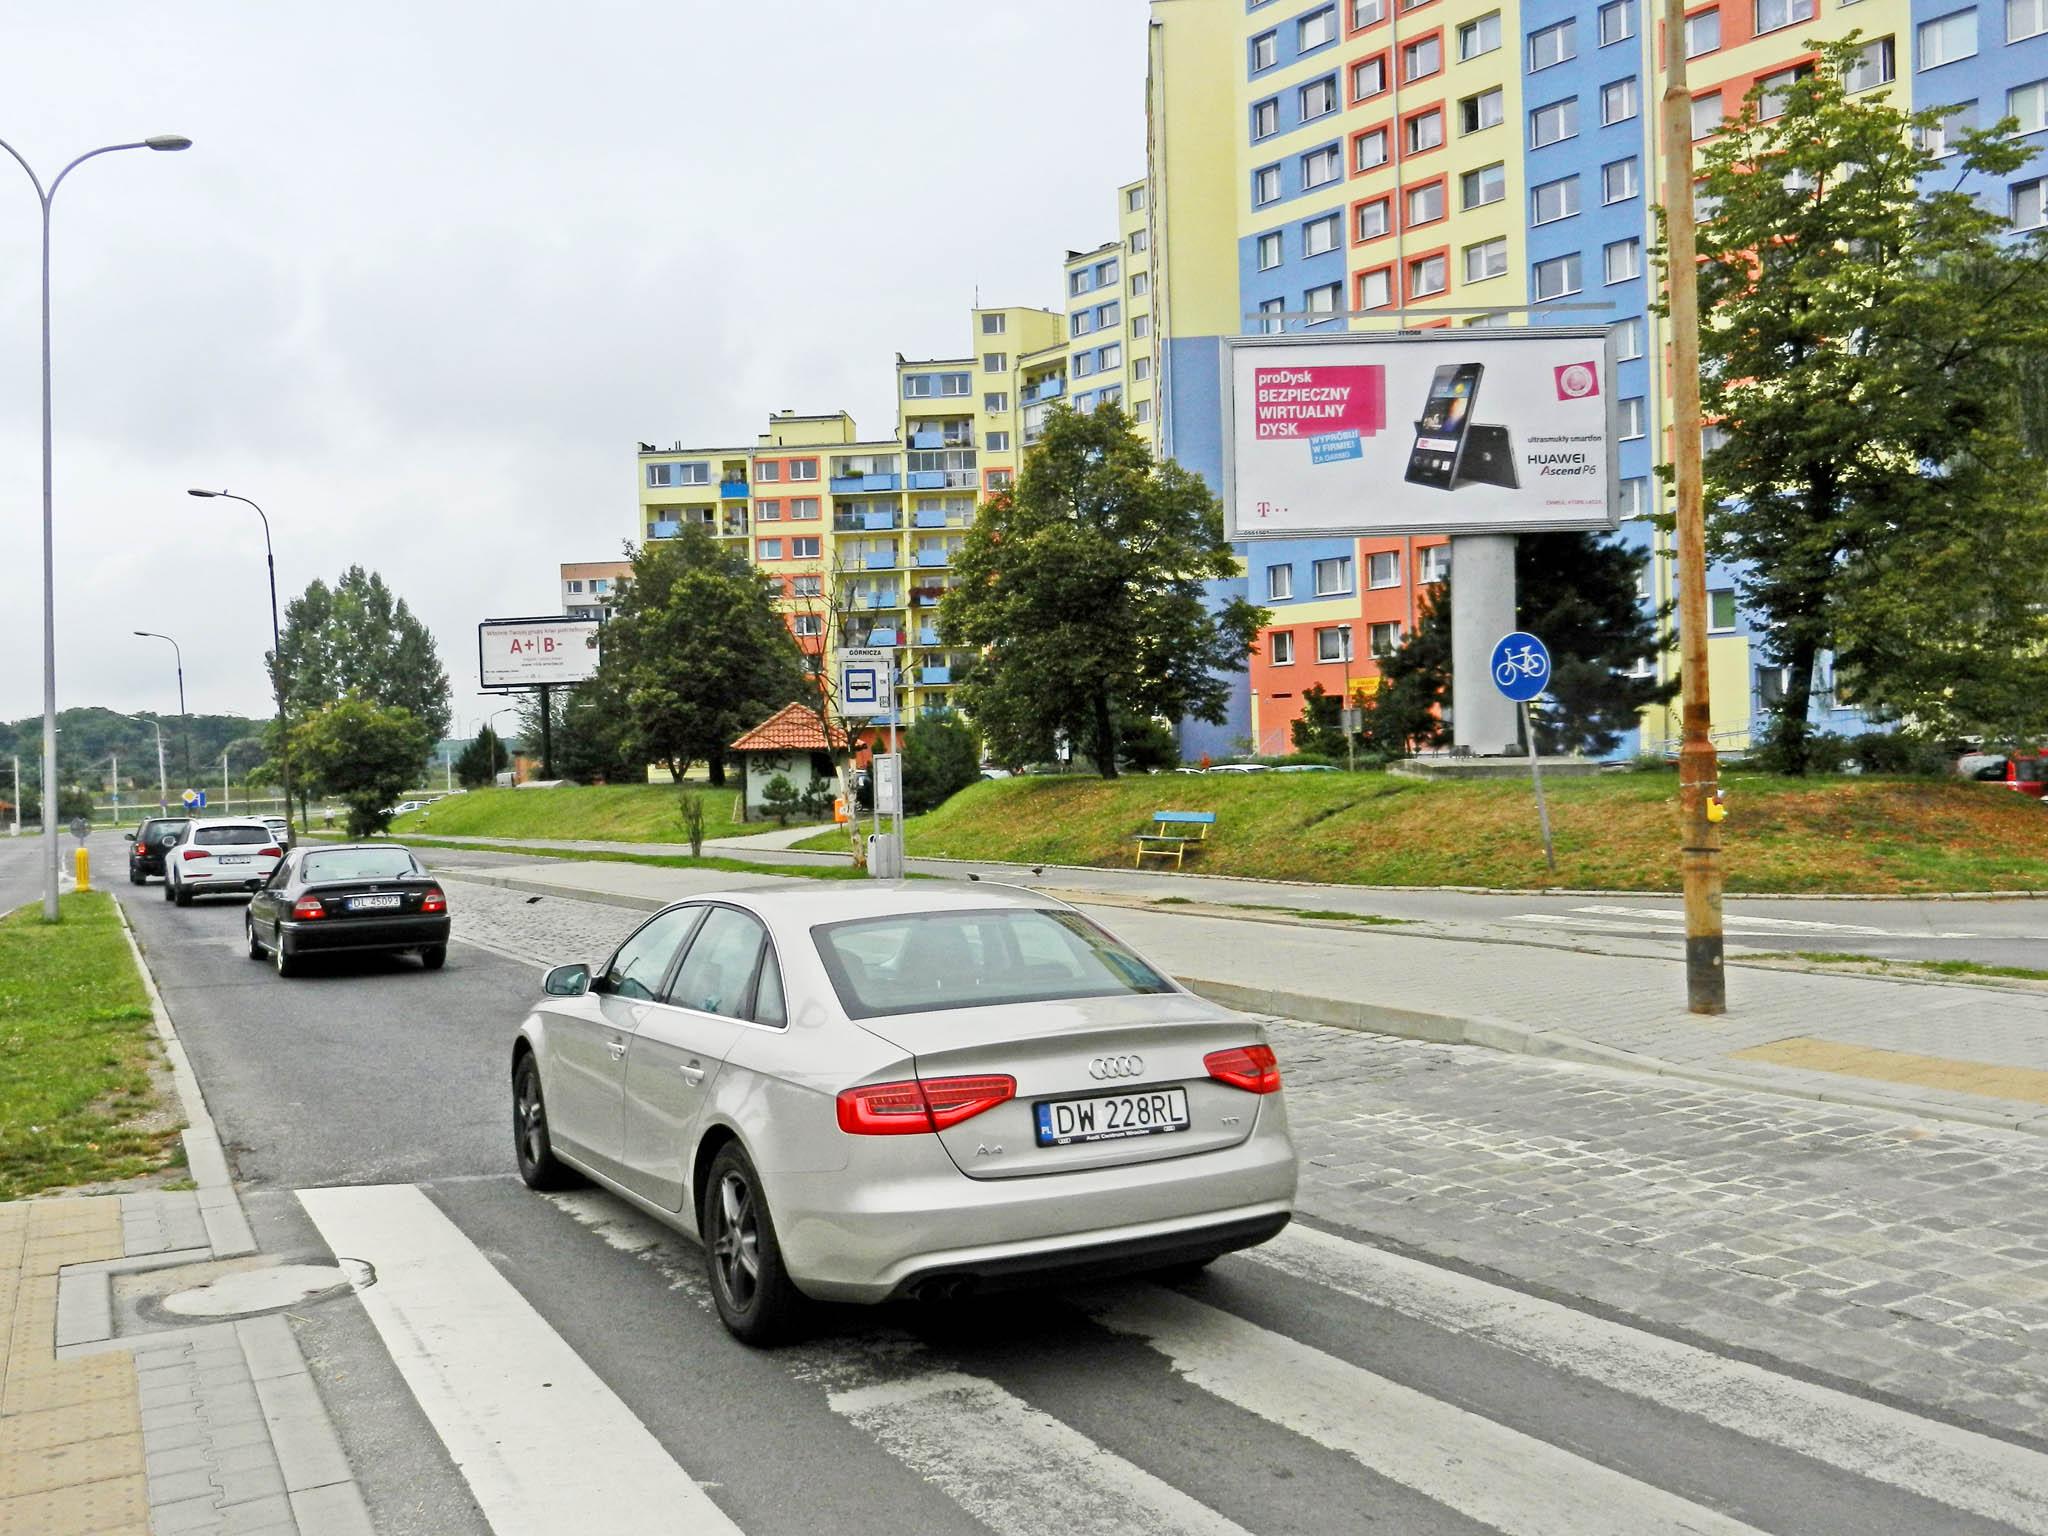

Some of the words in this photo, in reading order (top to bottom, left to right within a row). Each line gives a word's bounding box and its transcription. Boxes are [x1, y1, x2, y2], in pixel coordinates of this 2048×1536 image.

[1258, 371, 1312, 386] proDysk
[1258, 387, 1351, 403] BEZPIECZNY
[1259, 404, 1346, 419] WIRTUALNY
[1259, 422, 1298, 436] DYSK
[1312, 445, 1321, 453] W
[1527, 453, 1585, 465] HUAWEI
[1540, 465, 1581, 476] Ascend
[1582, 464, 1596, 475] P6
[354, 899, 367, 908] DL
[370, 896, 399, 906] 45093
[1056, 1103, 1095, 1134] DW
[1105, 1095, 1183, 1129] 228RL
[1041, 1126, 1052, 1135] PL
[1101, 1131, 1125, 1140] Centrum
